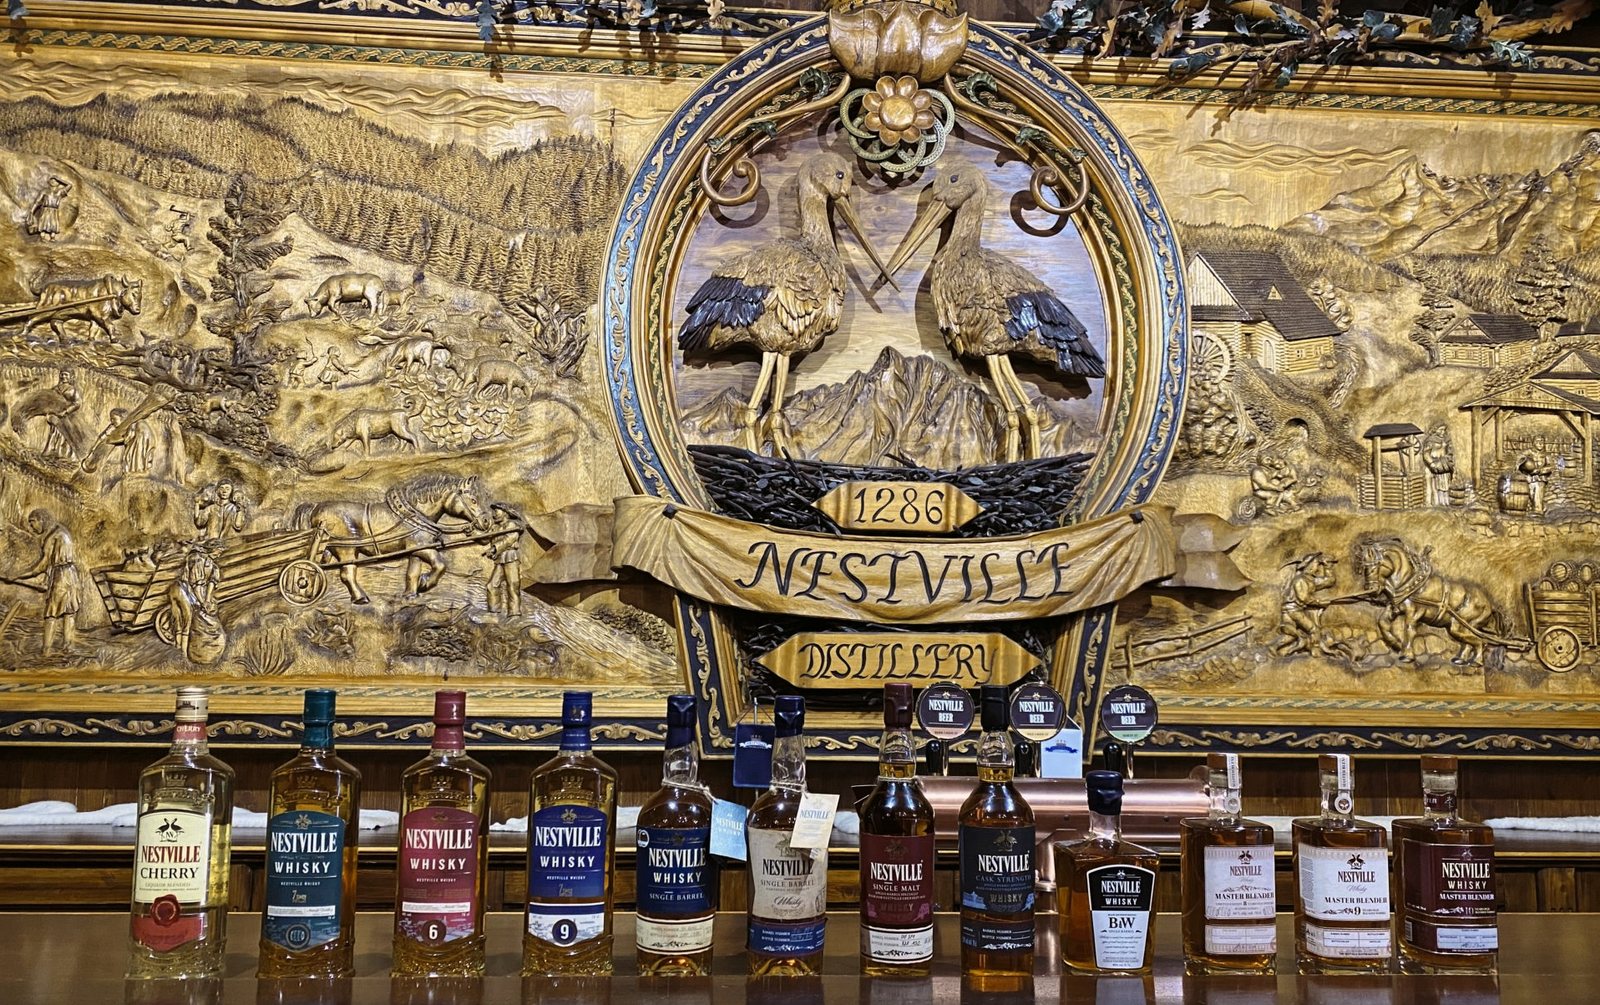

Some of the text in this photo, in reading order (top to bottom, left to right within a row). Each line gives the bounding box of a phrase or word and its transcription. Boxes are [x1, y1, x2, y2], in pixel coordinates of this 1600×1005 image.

[852, 486, 946, 526] 1286
[734, 540, 1077, 604] NESTVILLE
[798, 642, 995, 685] DISTILLERY
[928, 699, 964, 712] NESTVILLE
[1019, 701, 1054, 713] NESTVILLE
[1110, 702, 1146, 714] NESTVILLE
[938, 713, 954, 722] BEER
[1029, 714, 1045, 724] BEER
[1120, 715, 1136, 725] BEER
[271, 831, 338, 853] NESTVILLE
[405, 828, 473, 850] NESTVILLE
[535, 826, 602, 847] NESTVILLE
[140, 845, 201, 863] NESTVILLE
[648, 847, 707, 868] NESTVILLE
[274, 862, 331, 874] WHISKY
[410, 858, 467, 870] WHISKY
[540, 856, 596, 868] WHISKY
[762, 858, 814, 876] NESTVILLE
[978, 854, 1030, 873] NESTVILLE
[140, 868, 200, 879] CHERRY
[870, 862, 923, 881] NESTVILLE
[1230, 866, 1262, 876] NESTVILLE
[1337, 870, 1376, 883] NESTVILLE
[1442, 862, 1491, 879] NESTVILLE
[653, 872, 702, 884] WHISKY
[760, 879, 815, 888] SINGLE BARREL
[872, 884, 921, 892] SINGLE MALT
[1101, 880, 1141, 894] NESTVILLE
[1447, 881, 1488, 890] WHISKY
[649, 892, 704, 901] SINGLE BARREL
[990, 893, 1023, 903] WHISKY
[1105, 898, 1138, 906] WHISKY
[1215, 892, 1274, 900] MASTER BLENDER
[1324, 896, 1388, 904] MASTER BLENDER
[1440, 893, 1495, 901] MASTER BLENDER
[1354, 908, 1361, 916] 9
[428, 924, 438, 940] 6
[560, 924, 570, 940] 9
